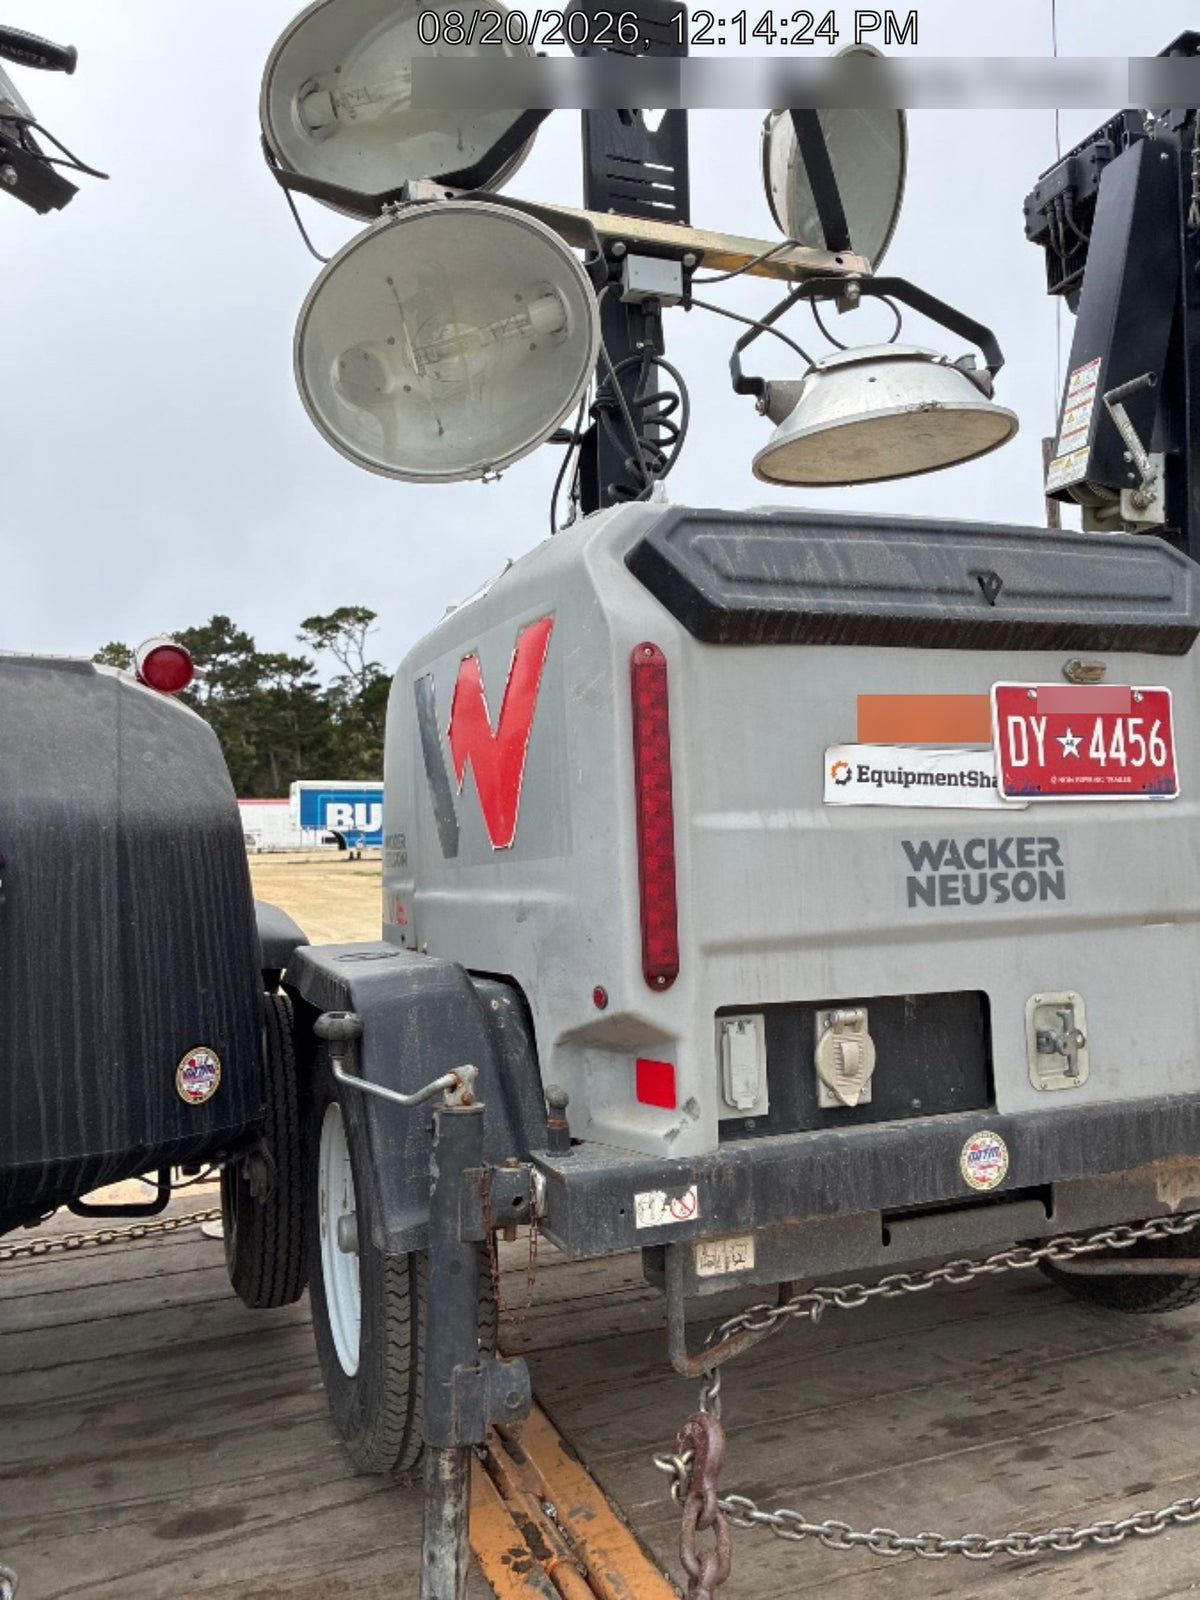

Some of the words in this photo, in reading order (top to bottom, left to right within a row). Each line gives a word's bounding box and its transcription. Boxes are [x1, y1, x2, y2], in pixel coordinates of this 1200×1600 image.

[1006, 715, 1047, 767] DY
[1088, 716, 1167, 767] 4456
[325, 802, 384, 832] BU
[900, 836, 1065, 873] WACKER
[906, 870, 1067, 909] NEUSON
